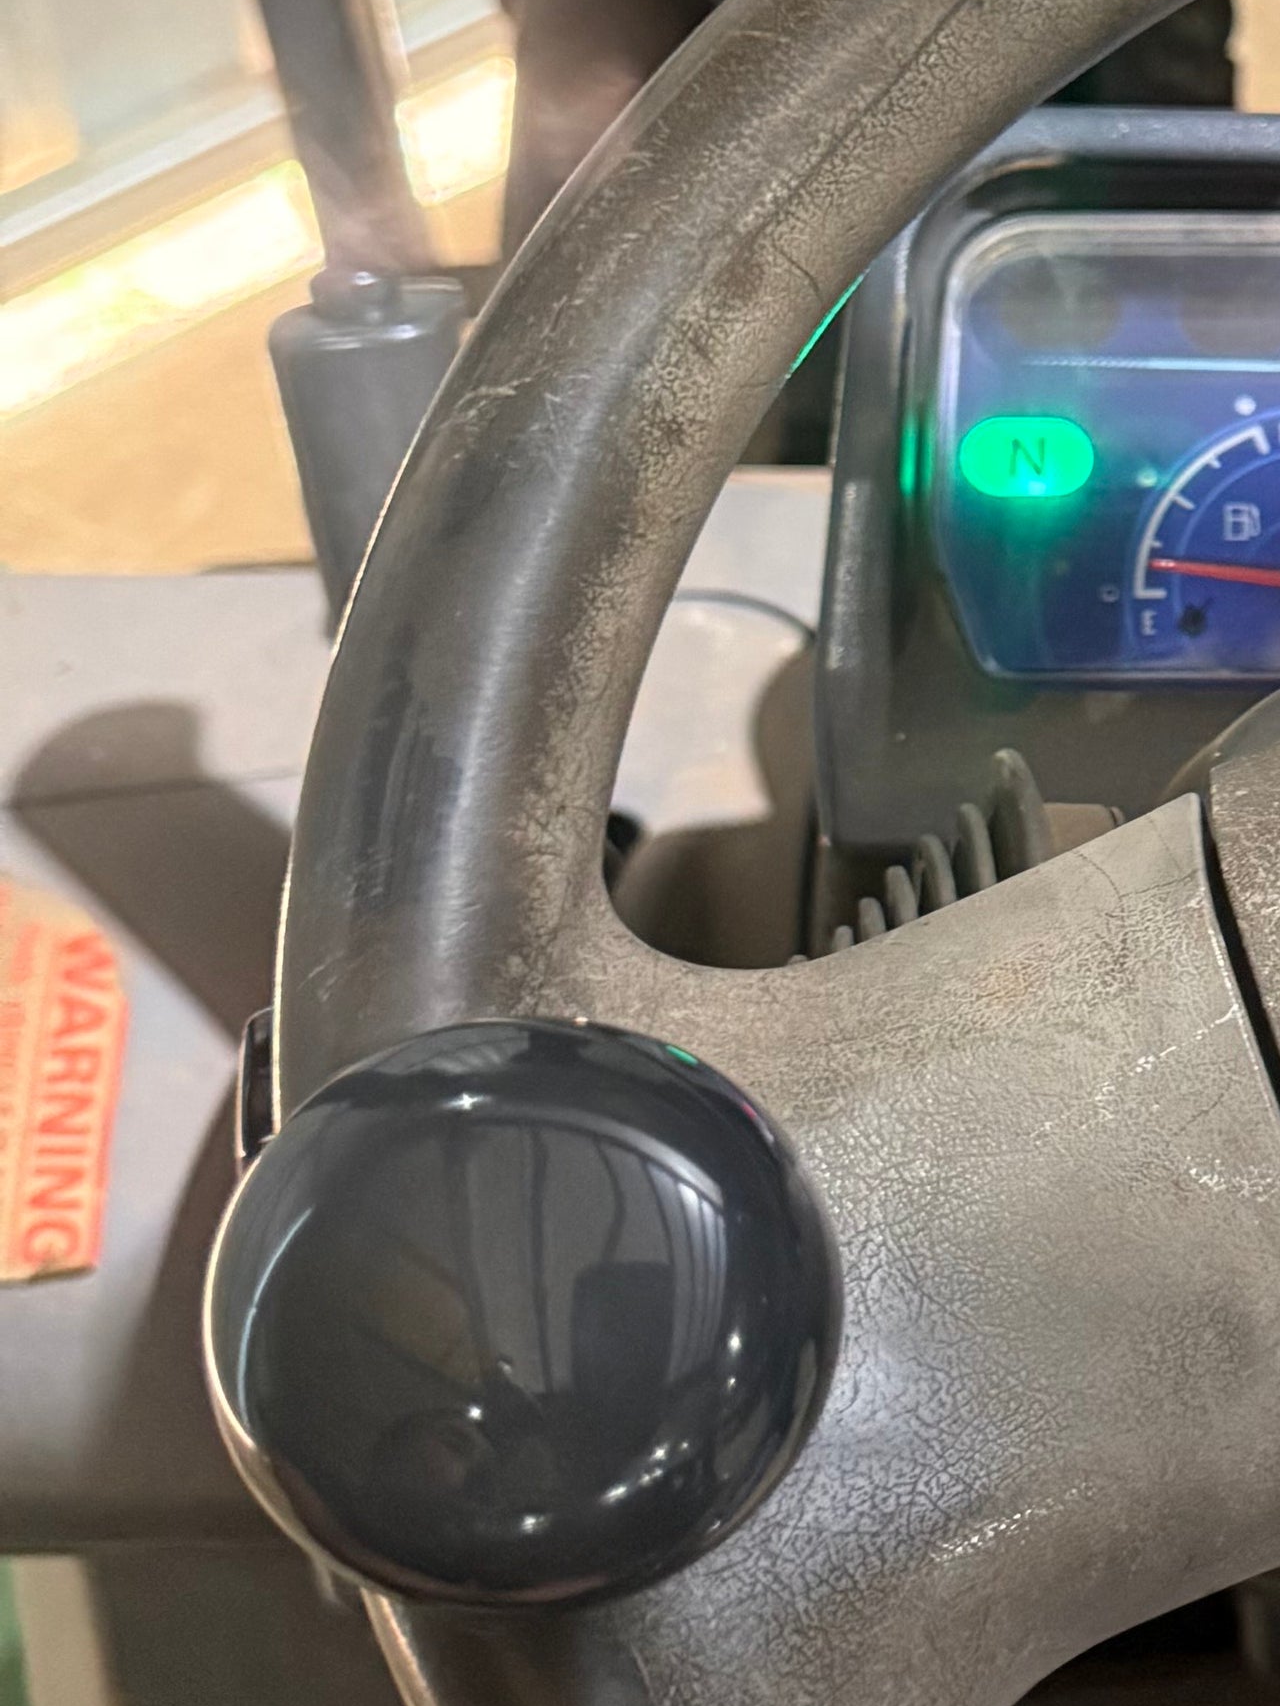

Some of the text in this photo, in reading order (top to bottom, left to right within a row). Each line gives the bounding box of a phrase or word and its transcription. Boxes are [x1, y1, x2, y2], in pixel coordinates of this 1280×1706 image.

[1009, 437, 1045, 476] N
[1141, 610, 1157, 636] E
[21, 932, 116, 1266] WARNING
